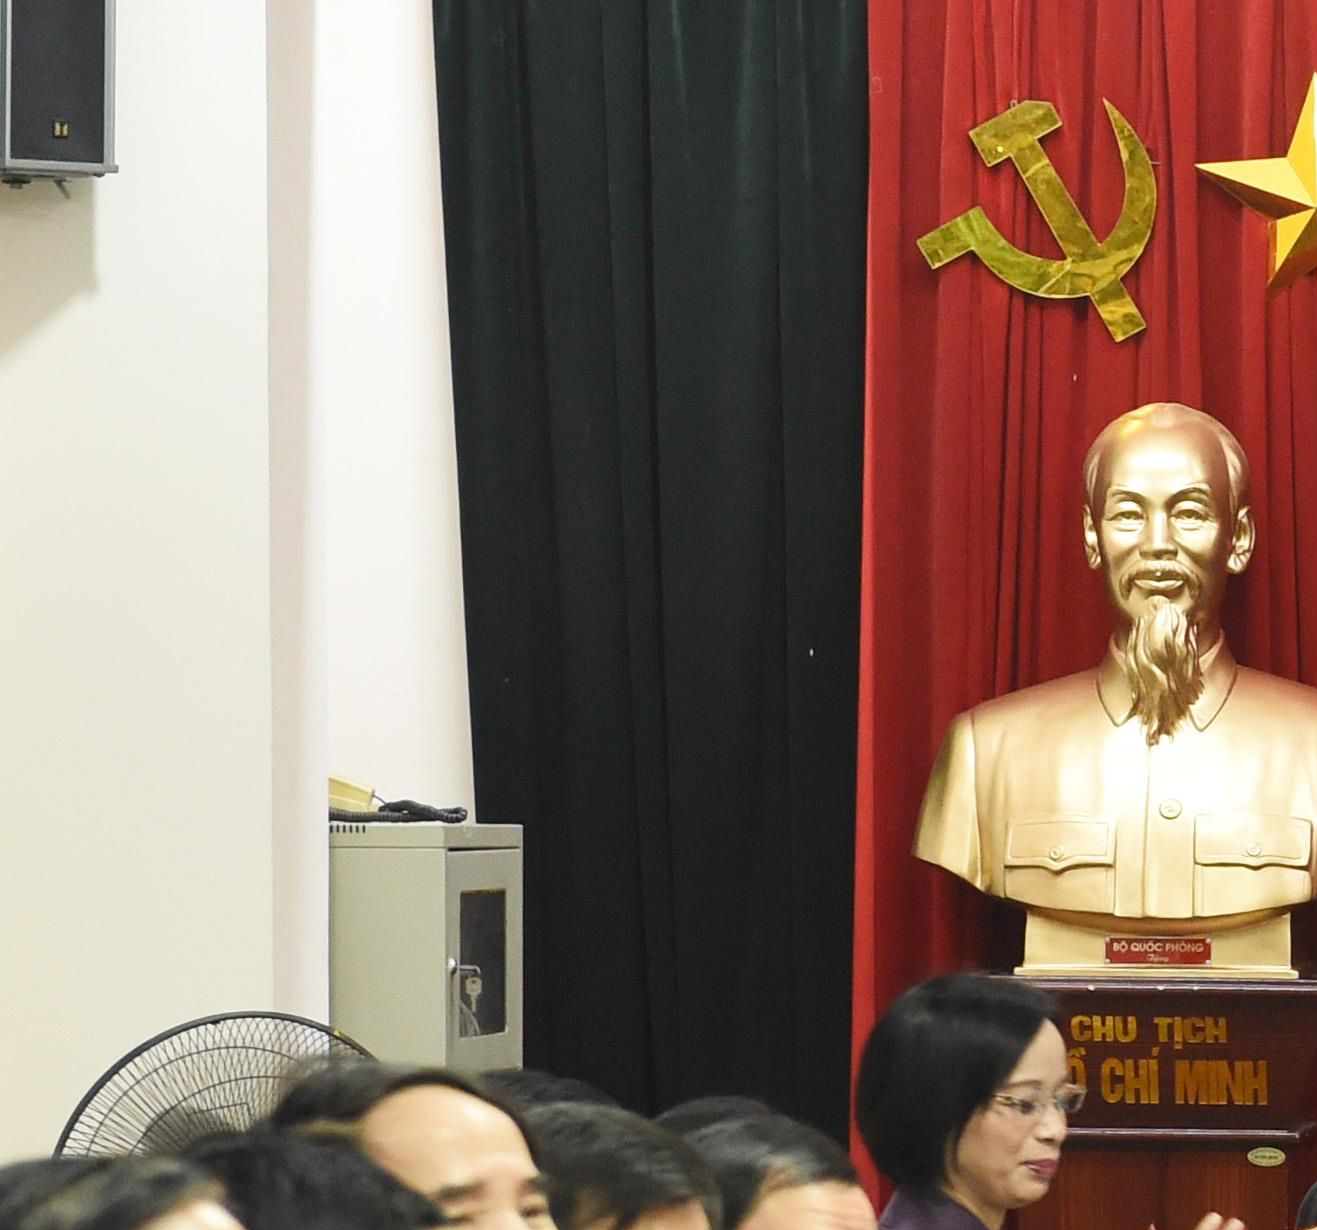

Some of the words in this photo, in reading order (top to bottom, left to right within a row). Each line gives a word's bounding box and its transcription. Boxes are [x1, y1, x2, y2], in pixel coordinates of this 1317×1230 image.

[1113, 940, 1128, 954] BỘ
[1130, 939, 1163, 952] QUỐC
[1165, 940, 1204, 953] PHÒNG
[1154, 1016, 1228, 1049] TỊCH
[1101, 1047, 1160, 1104] CHÍ
[1174, 1060, 1268, 1105] MINH
